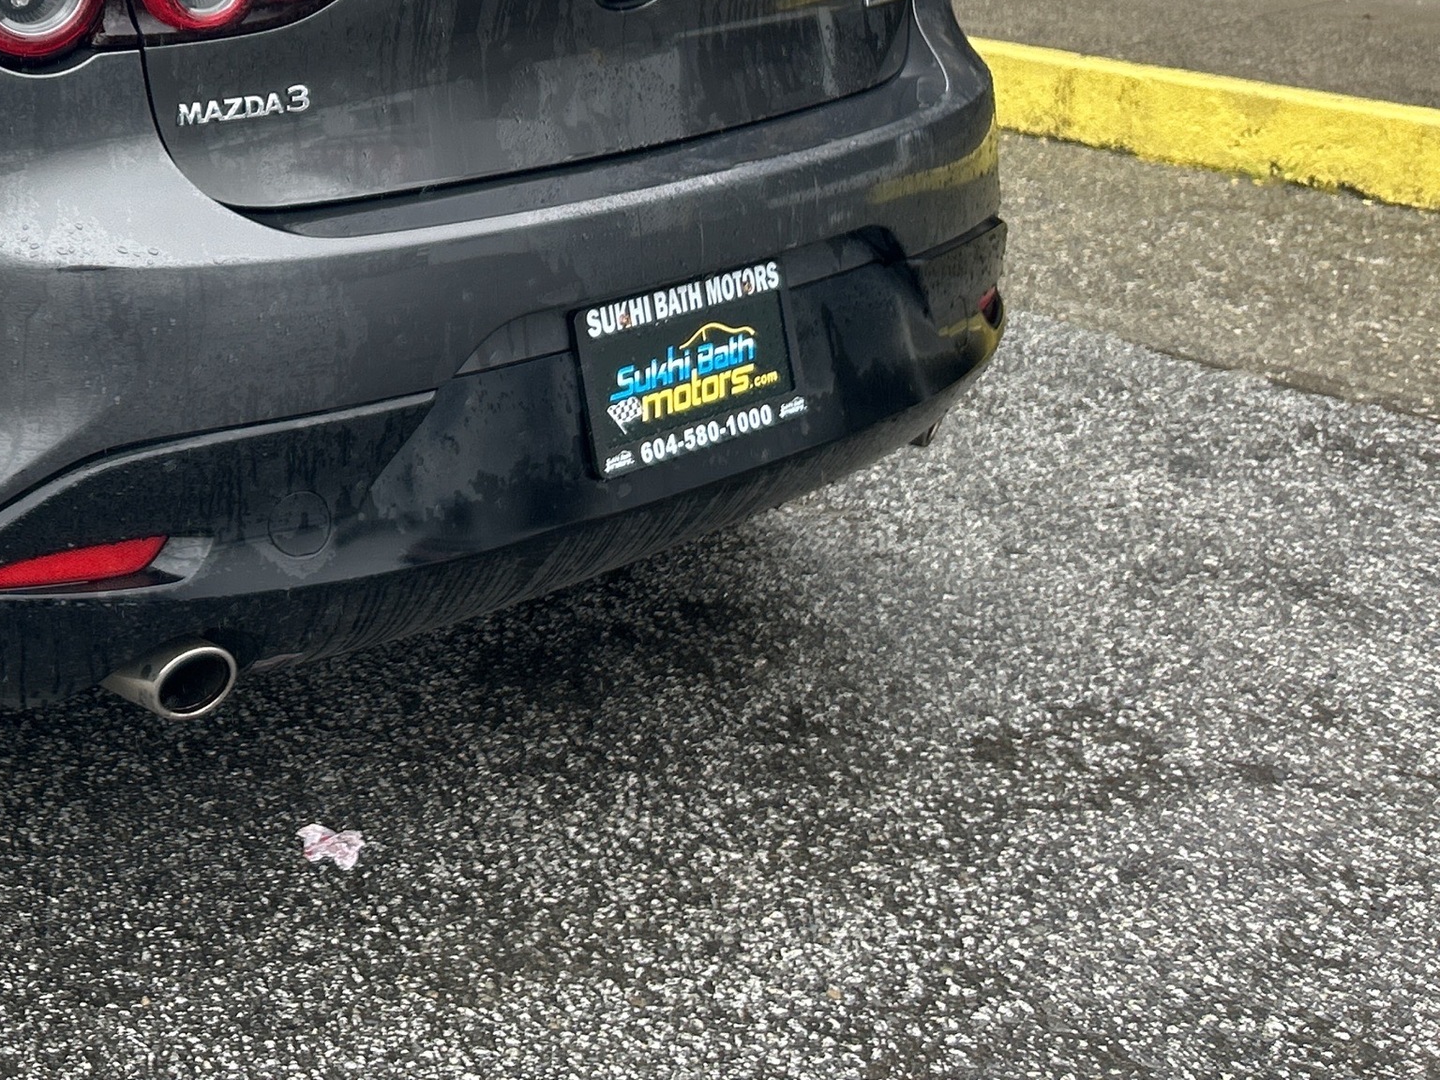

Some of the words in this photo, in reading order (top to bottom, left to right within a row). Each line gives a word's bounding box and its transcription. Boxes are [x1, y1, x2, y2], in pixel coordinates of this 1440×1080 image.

[586, 295, 652, 338] SUKHI
[653, 281, 702, 320] BATH
[706, 261, 780, 307] MOTORS
[610, 344, 693, 401] Sukhi
[697, 333, 756, 370] Bath
[640, 404, 773, 463] 604-580-1000
